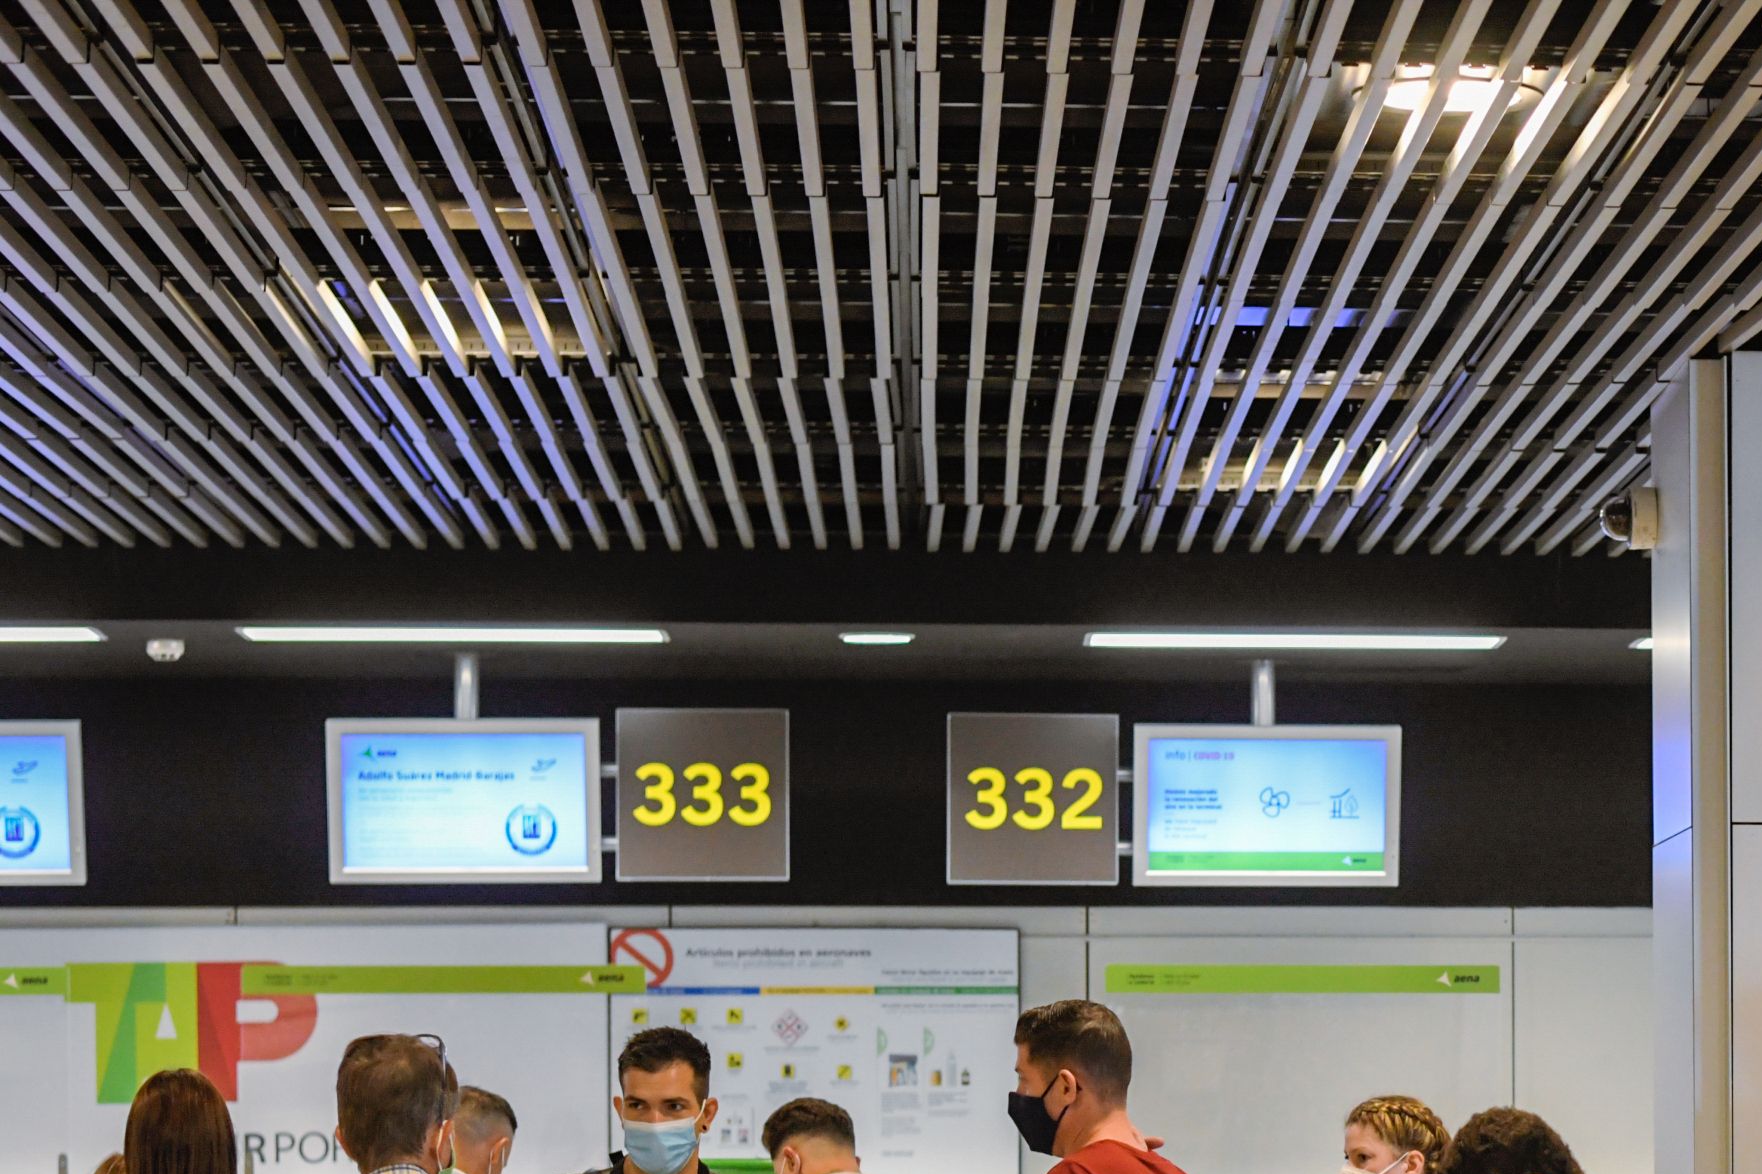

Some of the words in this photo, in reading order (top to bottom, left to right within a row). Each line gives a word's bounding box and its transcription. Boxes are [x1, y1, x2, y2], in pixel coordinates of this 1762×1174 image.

[632, 762, 772, 827] 333
[964, 766, 1104, 831] 332
[1454, 974, 1480, 984] aena
[65, 960, 318, 1104] TAP
